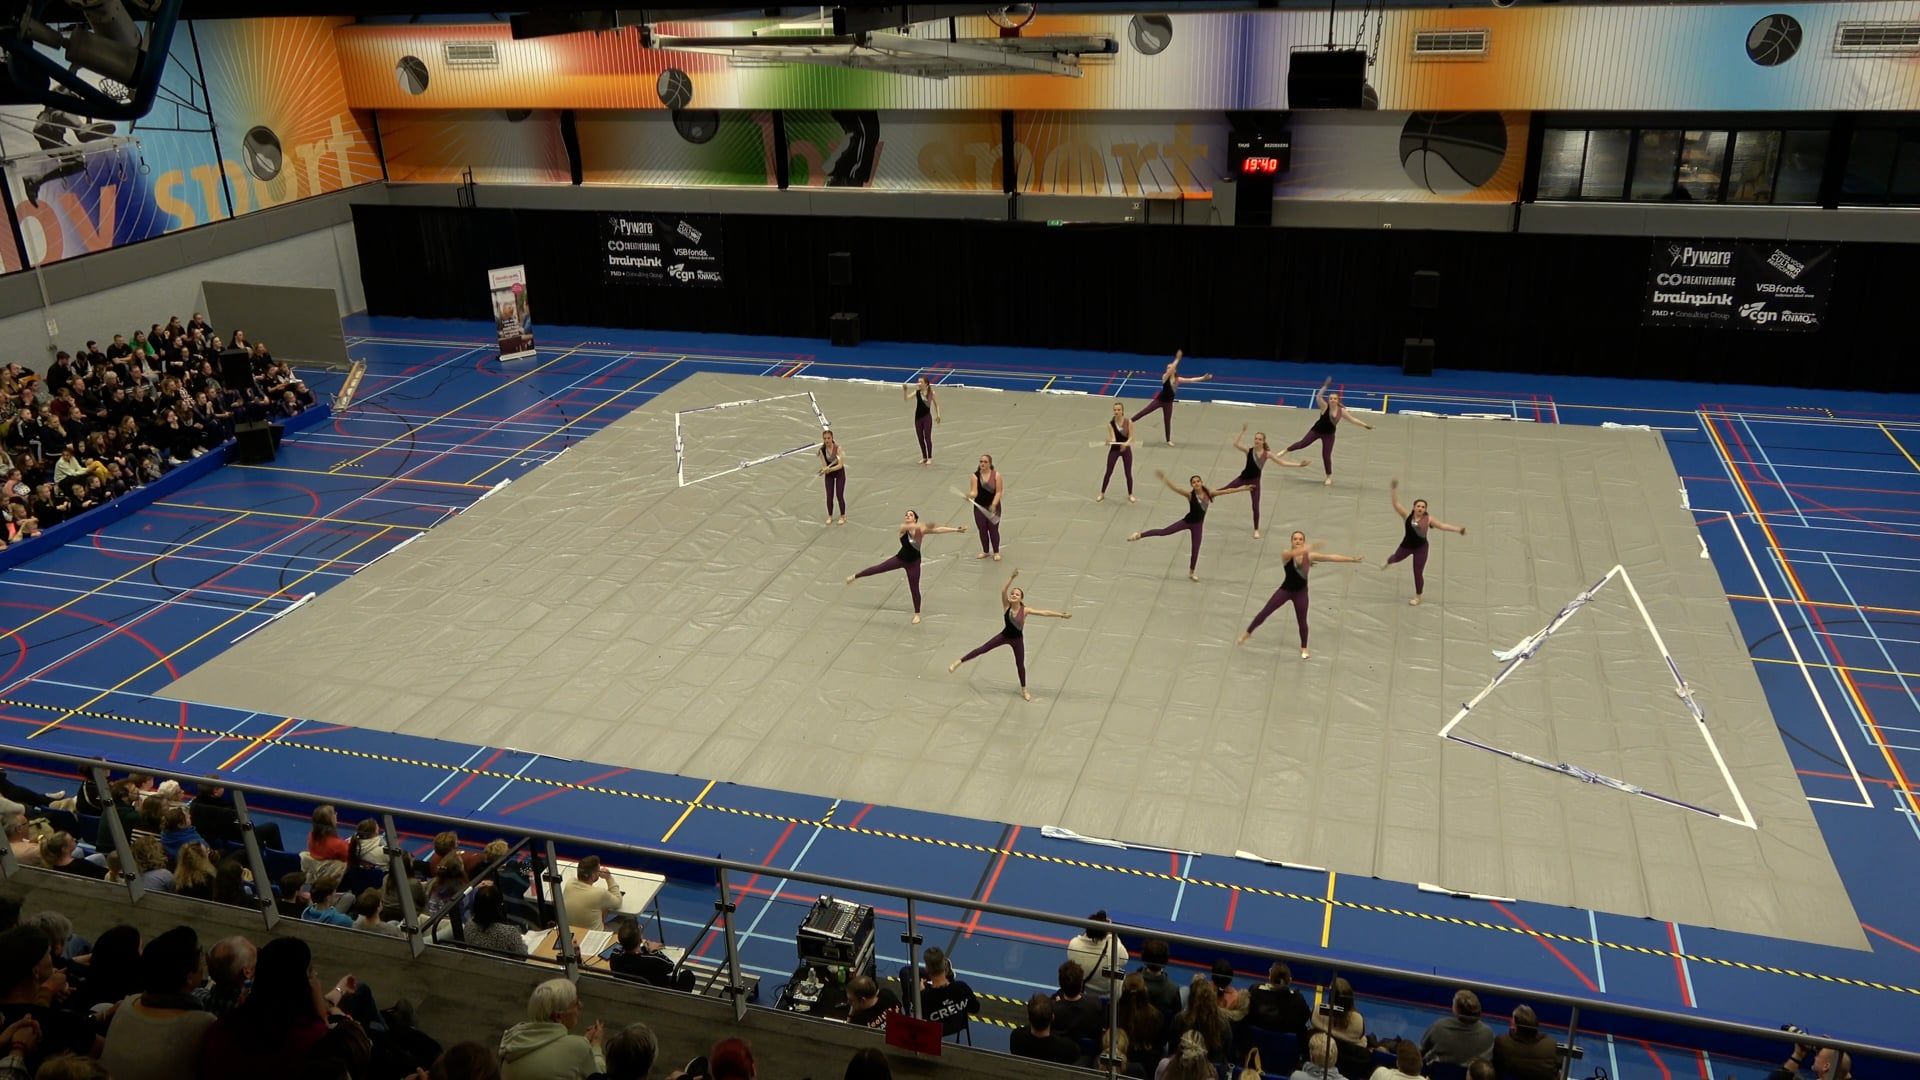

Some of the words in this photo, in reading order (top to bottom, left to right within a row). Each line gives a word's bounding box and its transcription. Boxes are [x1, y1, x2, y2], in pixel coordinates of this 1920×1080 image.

[1243, 158, 1278, 171] 19:40
[620, 219, 653, 236] Pyware
[609, 255, 662, 268] brainpink
[1682, 247, 1731, 267] Pyware
[676, 271, 695, 282] cgn
[1653, 291, 1733, 306] brainpink
[1675, 310, 1710, 319] Consulting
[1710, 312, 1730, 320] Group
[1750, 310, 1777, 324] cgn
[930, 998, 968, 1022] CREW
